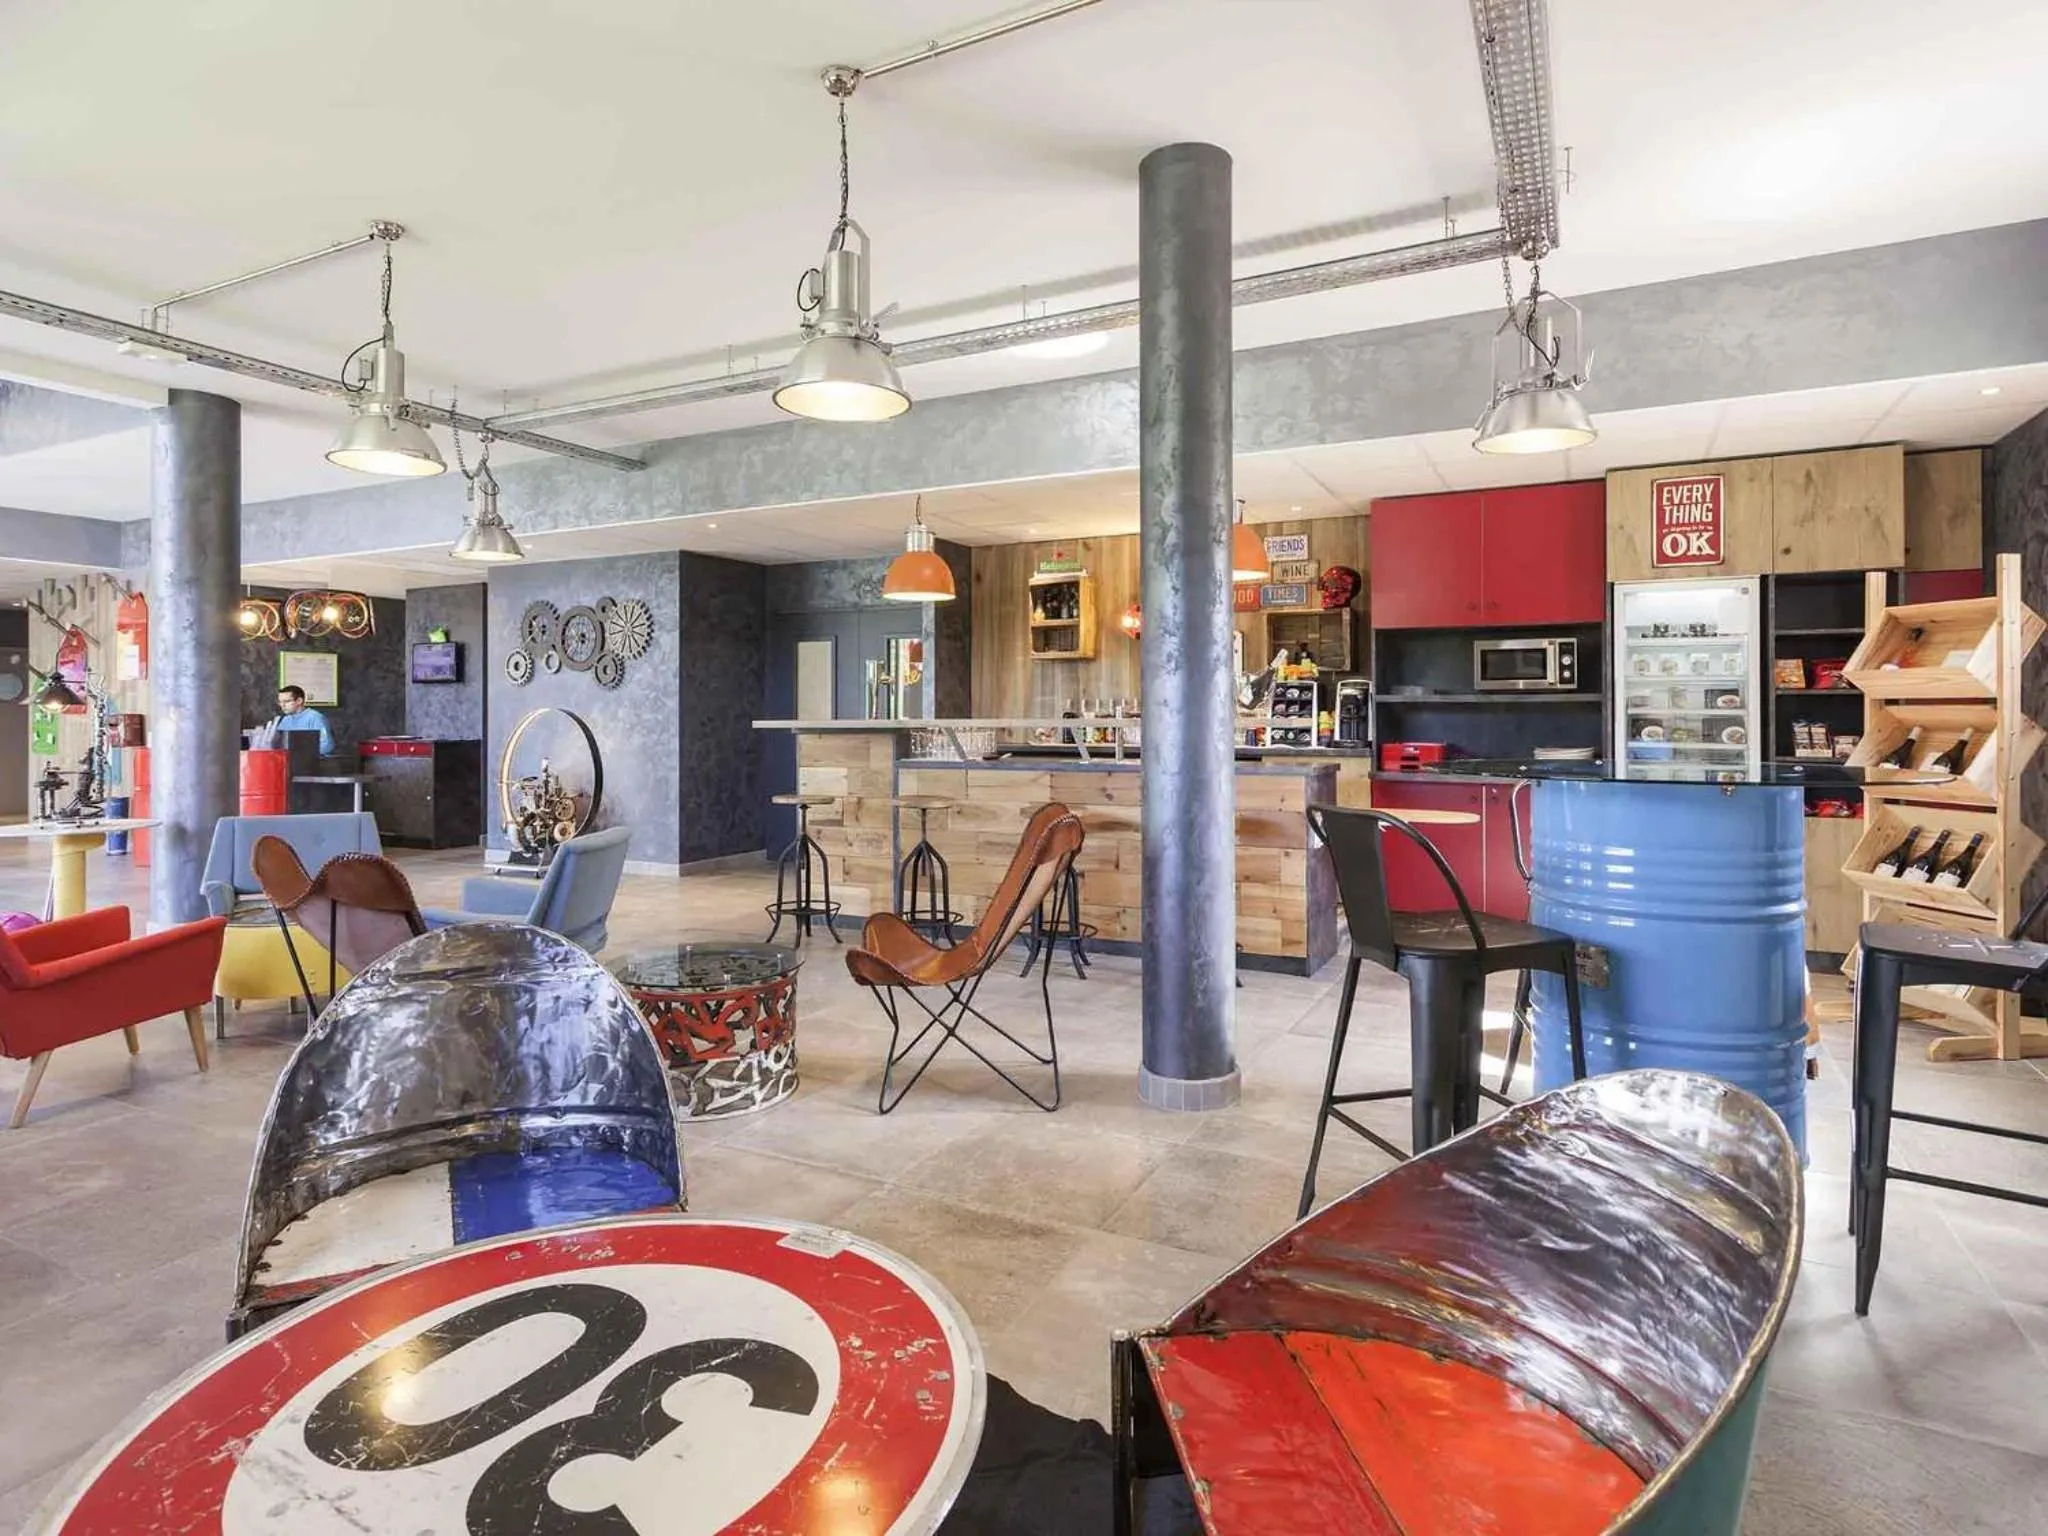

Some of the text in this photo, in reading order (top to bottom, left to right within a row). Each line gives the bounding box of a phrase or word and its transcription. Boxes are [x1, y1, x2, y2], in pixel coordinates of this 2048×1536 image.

[1662, 483, 1714, 506] EVERY
[1664, 503, 1713, 526] THING
[1266, 538, 1304, 552] FRIENDS
[1662, 531, 1716, 558] OK
[1280, 564, 1309, 578] WINE
[303, 1283, 820, 1536] 30
